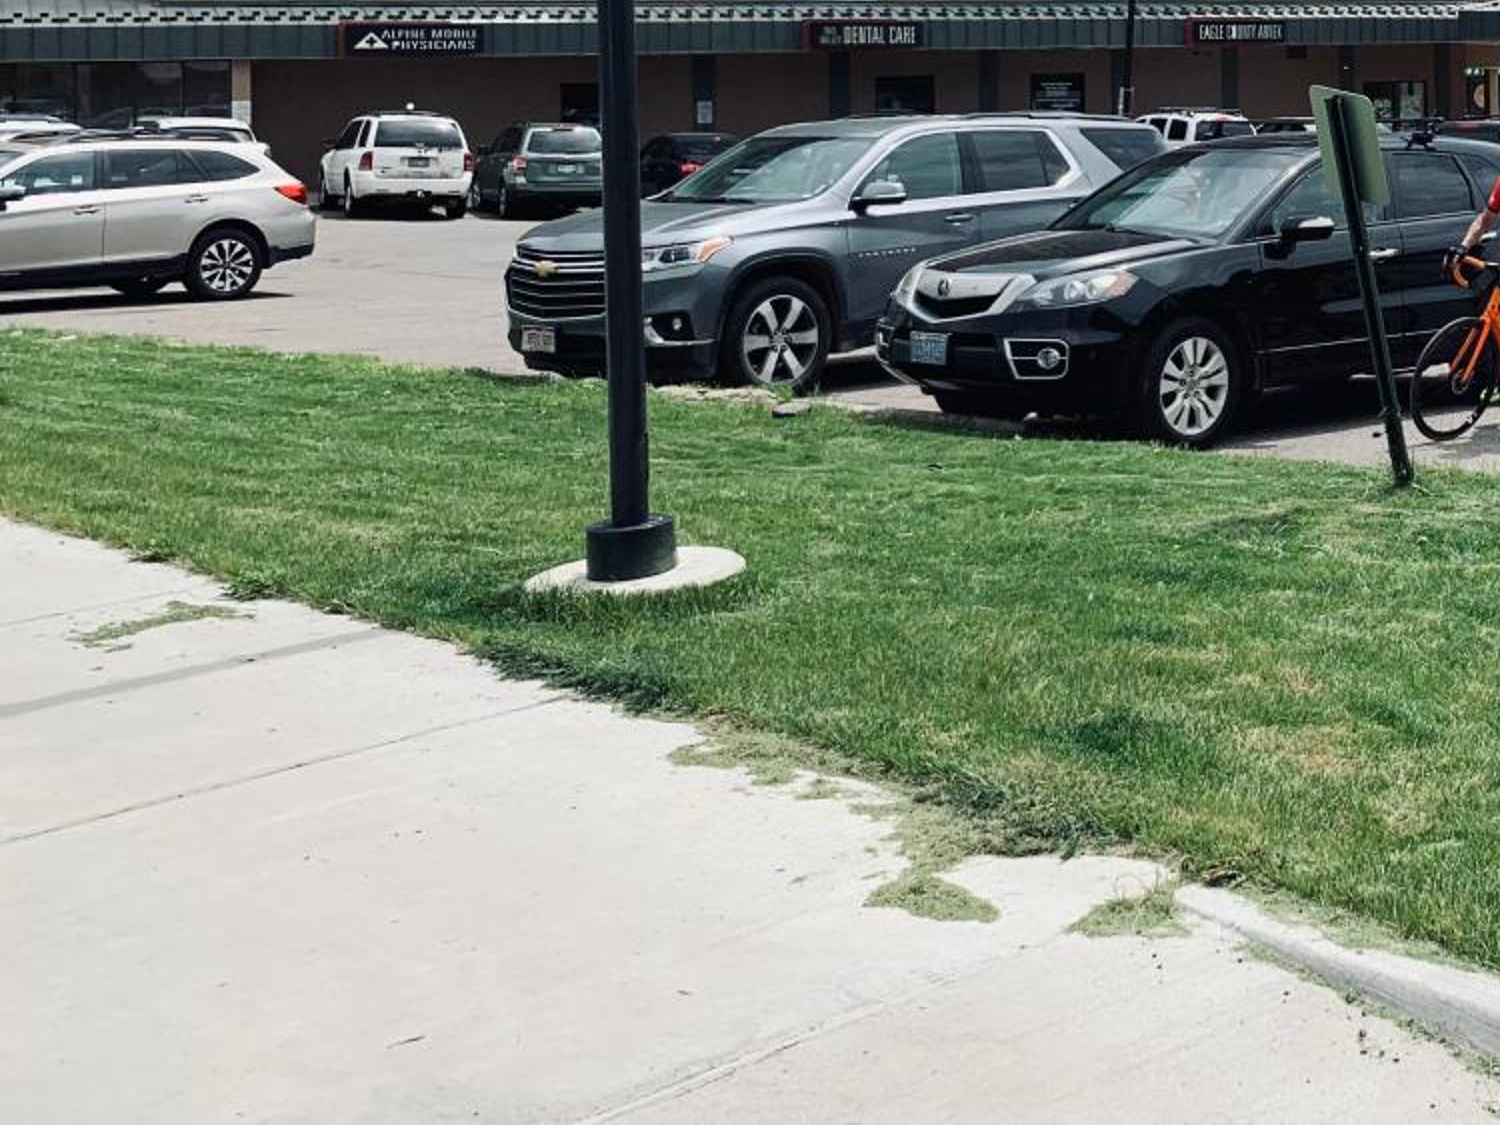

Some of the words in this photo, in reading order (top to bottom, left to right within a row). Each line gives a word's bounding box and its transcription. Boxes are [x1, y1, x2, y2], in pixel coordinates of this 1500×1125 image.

[381, 28, 427, 40] ALPINE
[431, 28, 477, 40] MOBILE
[843, 26, 885, 44] DENTAL
[889, 26, 915, 44] CARE
[1200, 24, 1225, 40] EAGLE
[391, 40, 476, 50] PHYSICIANS
